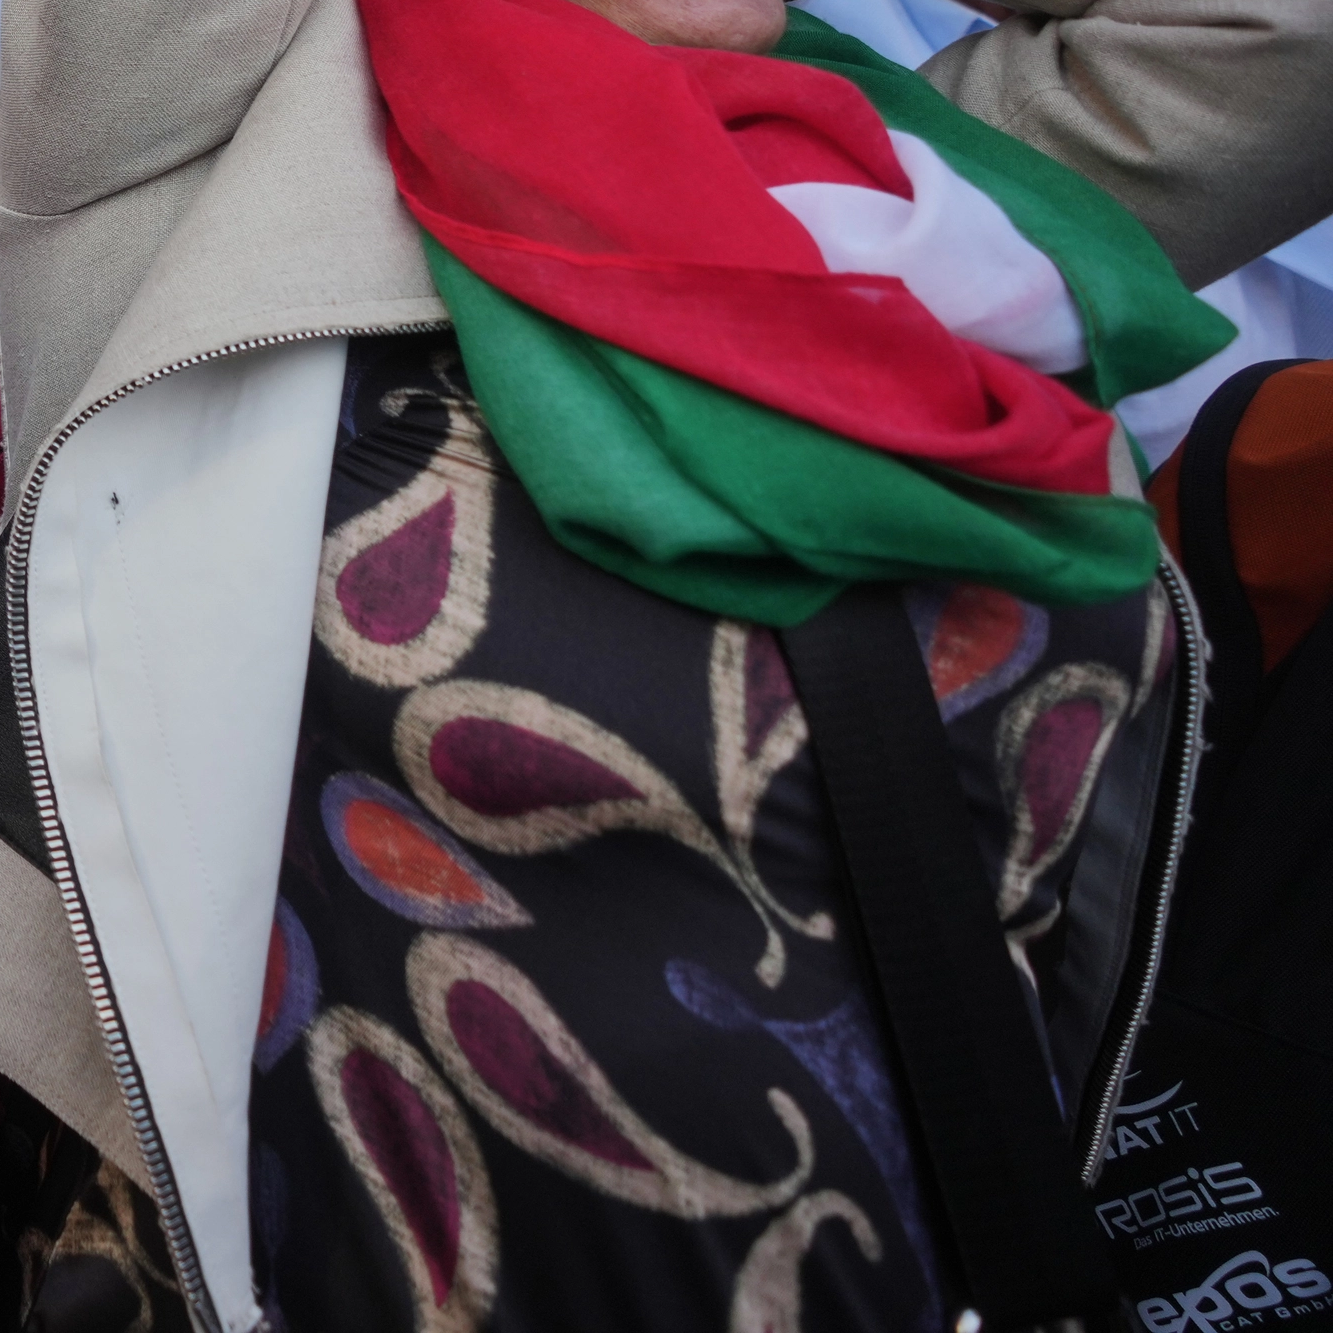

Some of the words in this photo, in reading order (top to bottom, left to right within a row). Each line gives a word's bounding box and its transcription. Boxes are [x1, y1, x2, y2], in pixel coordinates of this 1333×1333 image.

[1168, 1101, 1199, 1137] IT
[1133, 1234, 1153, 1251] Das
[1153, 1206, 1280, 1243] IT-Unternehmen.
[1136, 1249, 1332, 1333] epos
[1219, 1311, 1265, 1331] CAT
